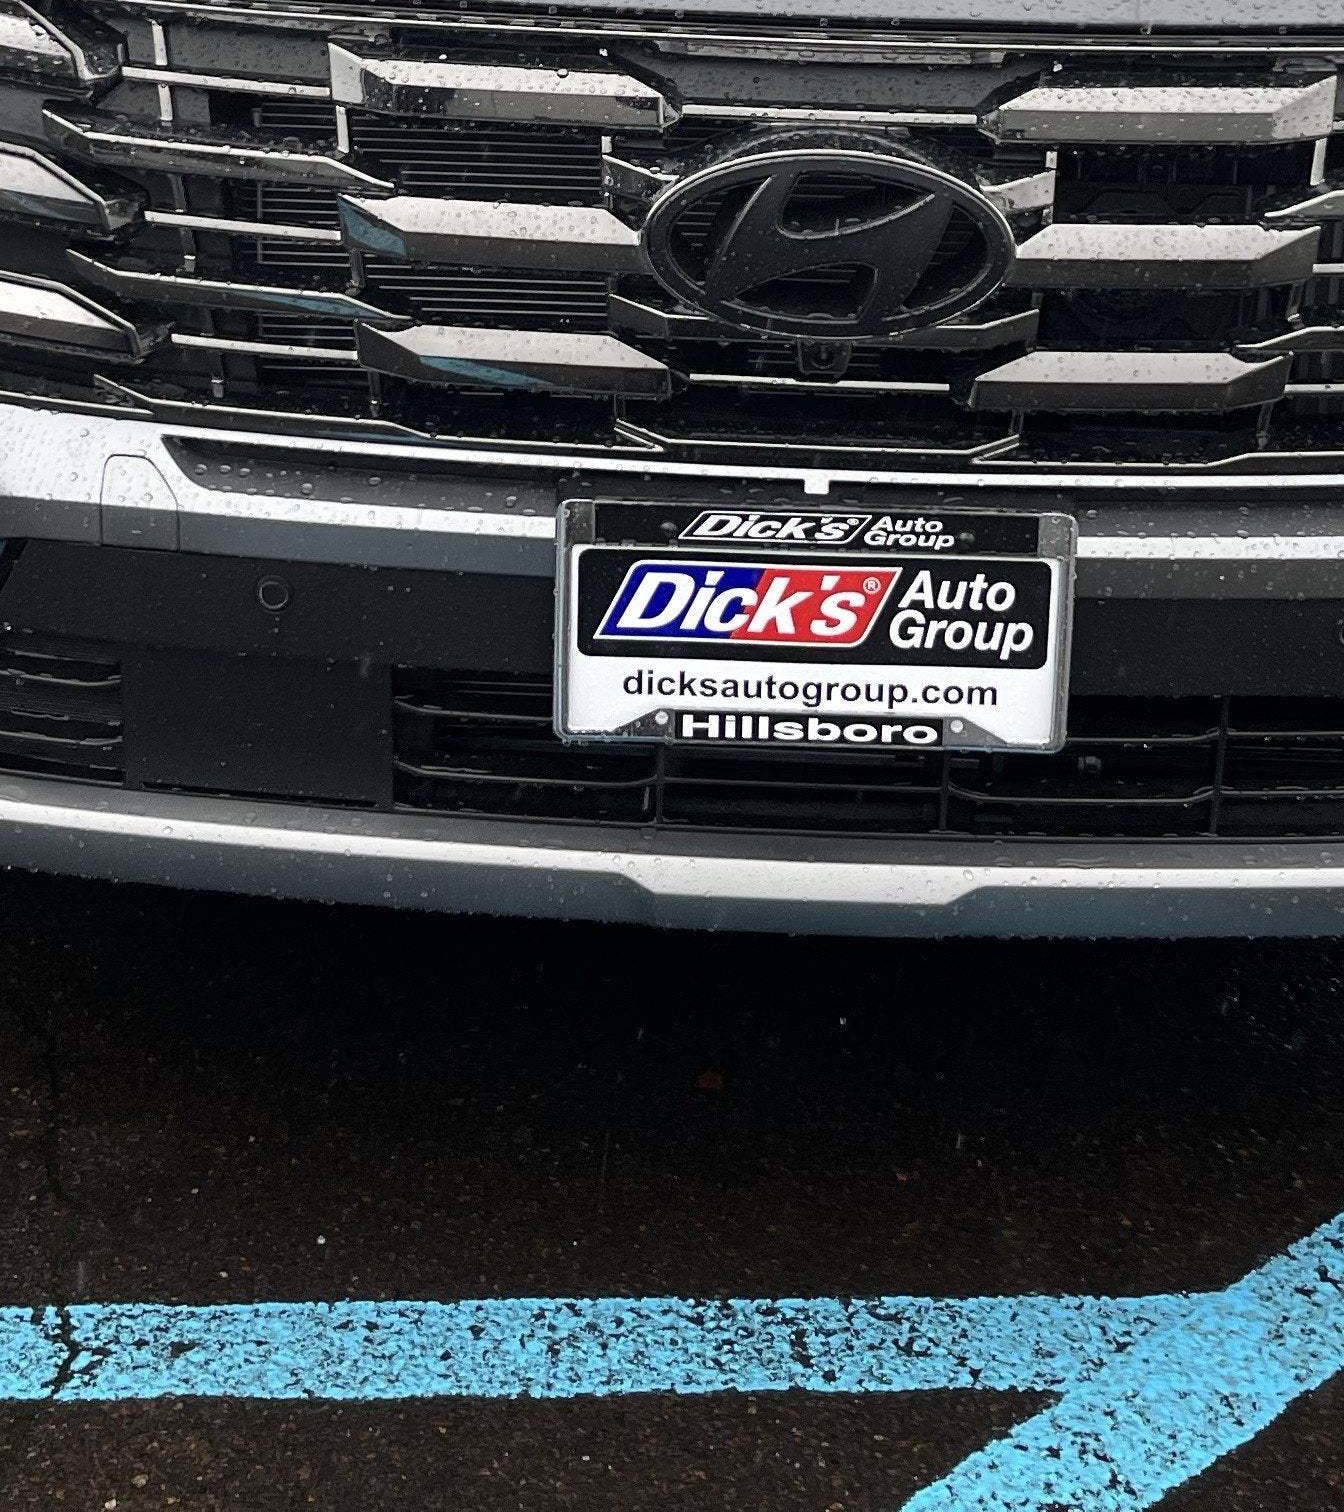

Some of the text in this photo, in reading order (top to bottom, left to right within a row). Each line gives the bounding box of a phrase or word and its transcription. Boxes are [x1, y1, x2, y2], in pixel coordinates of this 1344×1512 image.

[863, 530, 955, 550] Group
[870, 516, 943, 534] Auto
[616, 571, 868, 637] Dick's
[897, 570, 1016, 613] Auto
[888, 610, 1034, 661] Group
[623, 669, 998, 709] dicksautogroup.com
[681, 714, 938, 745] Hillsboro
